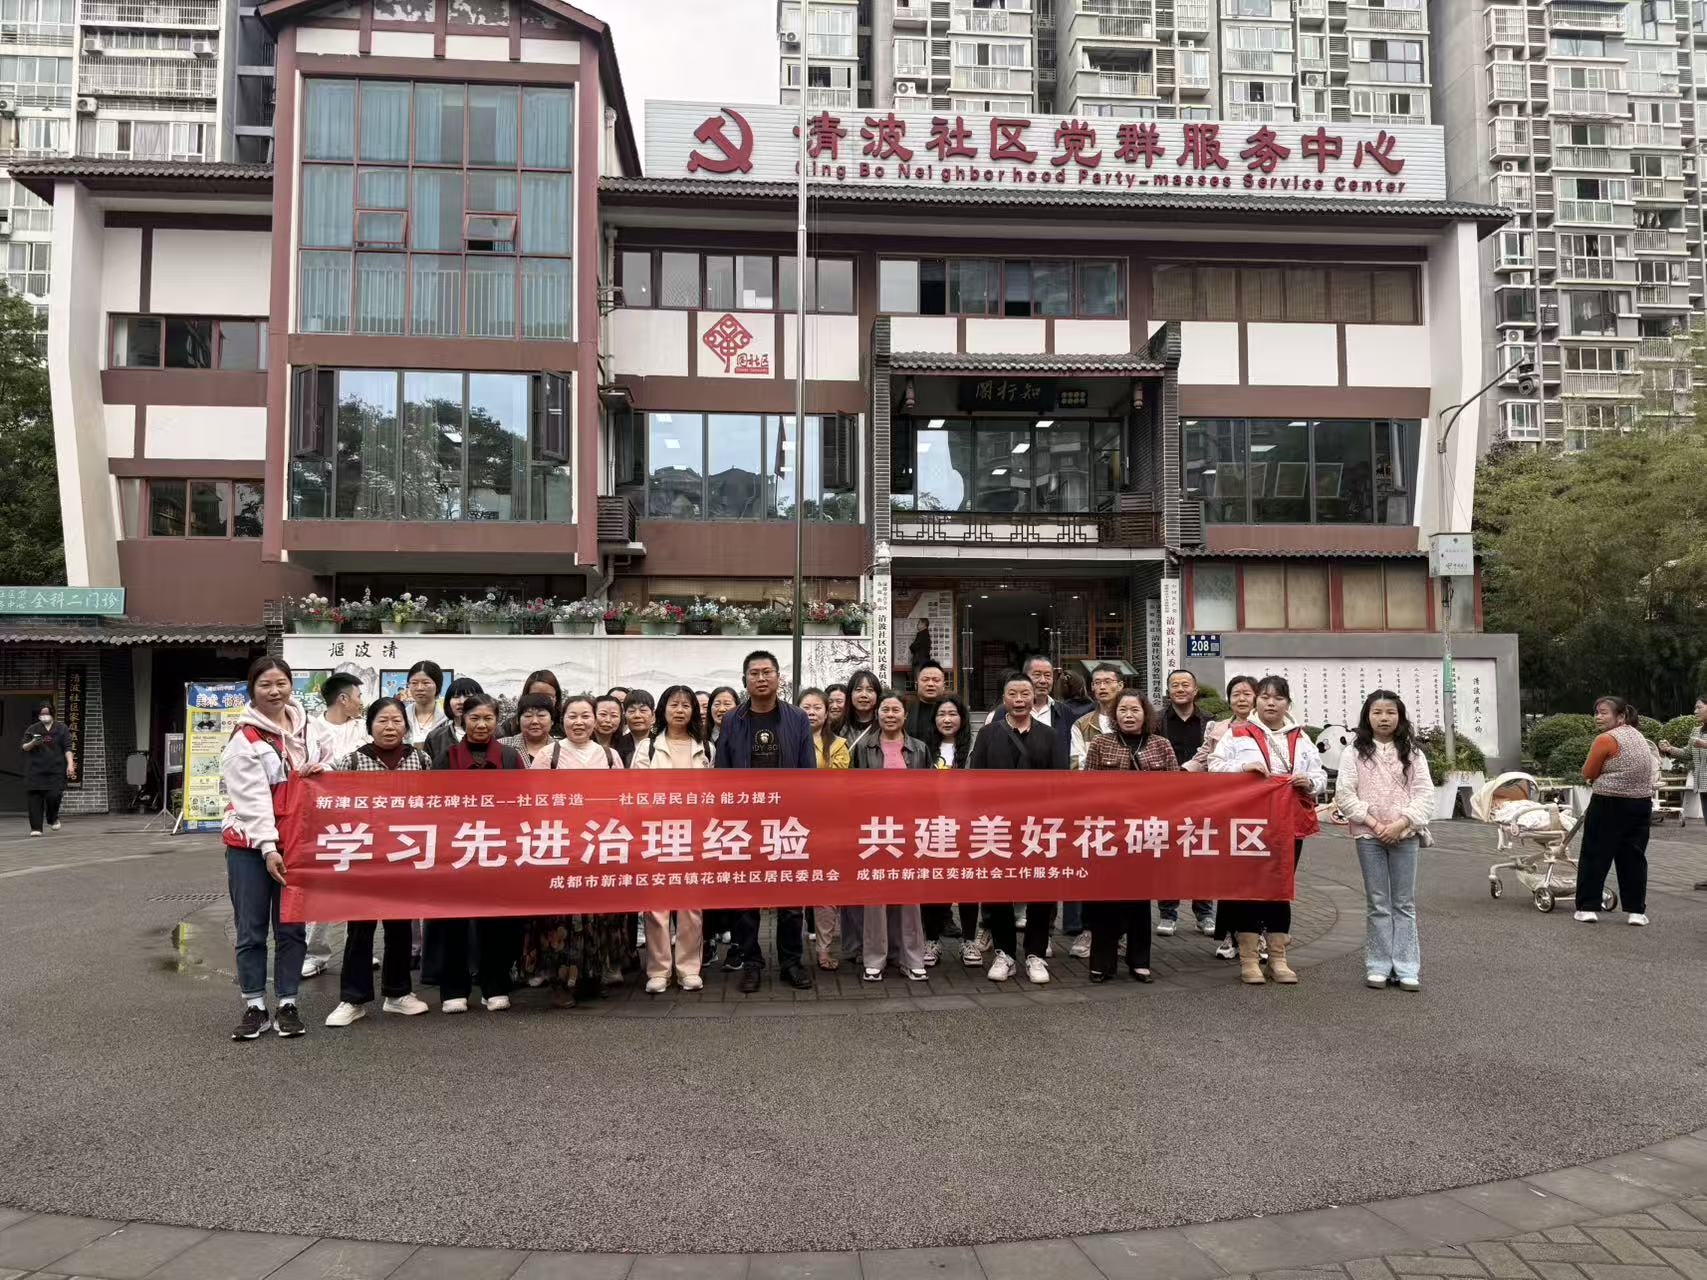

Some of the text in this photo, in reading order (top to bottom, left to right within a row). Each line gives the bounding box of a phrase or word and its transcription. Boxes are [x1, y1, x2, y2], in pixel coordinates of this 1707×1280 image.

[792, 110, 1405, 175] 清波社区党群服务中心
[859, 162, 885, 178] Bo
[898, 163, 1066, 183] Neighborhood
[1243, 173, 1324, 191] Service
[1335, 176, 1406, 193] Center
[1167, 617, 1176, 676] 清波社区委
[1191, 640, 1209, 651] 208
[315, 815, 1272, 872] 学习先进治理经验 共建美好花碑社区
[549, 868, 841, 889] 成都市新津区安西镇花碑社区居民委员会
